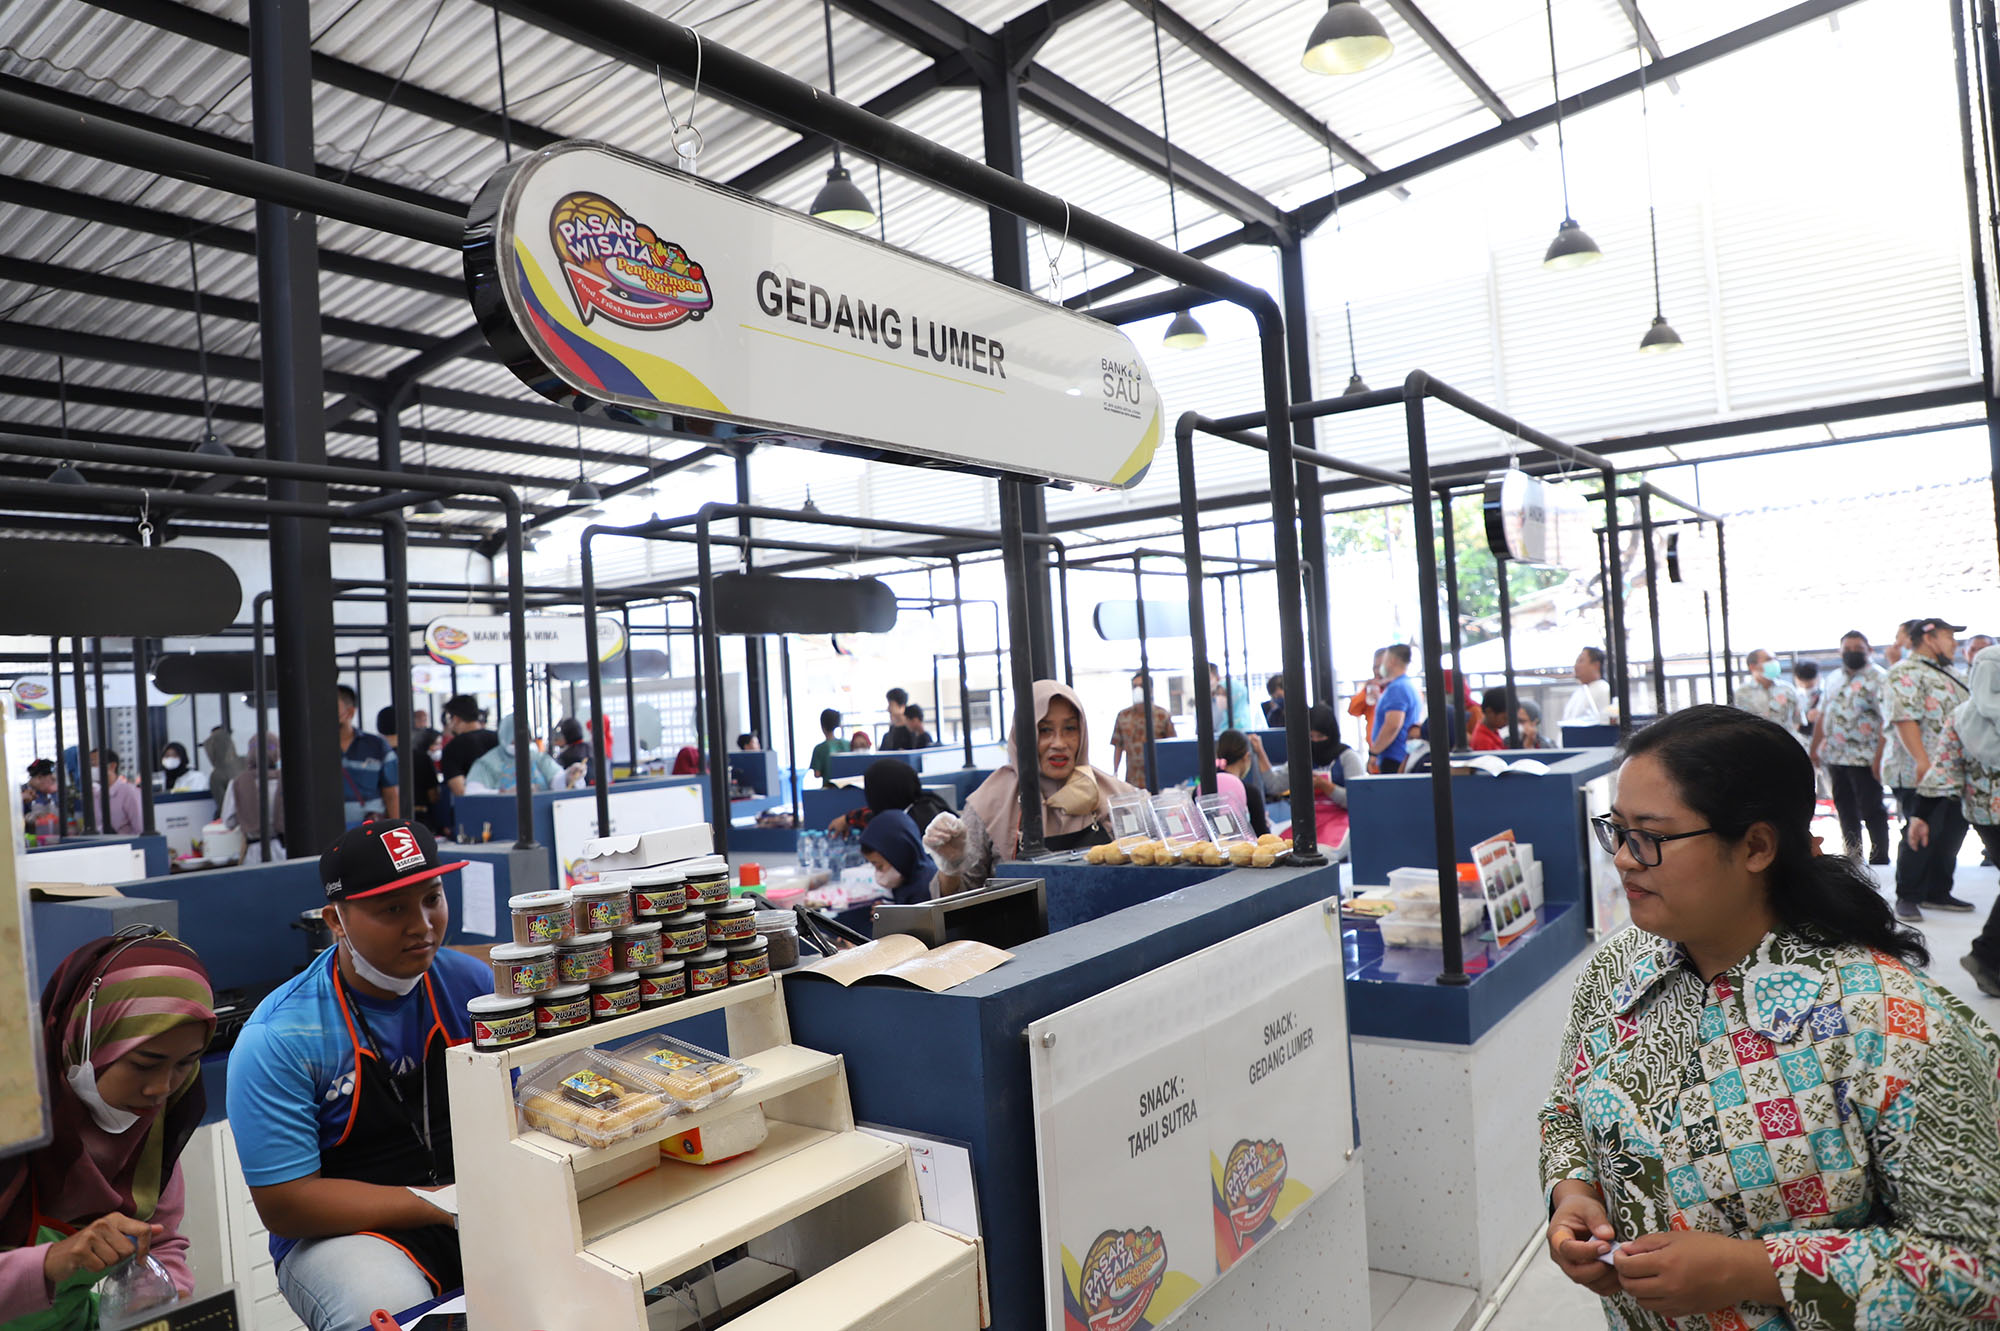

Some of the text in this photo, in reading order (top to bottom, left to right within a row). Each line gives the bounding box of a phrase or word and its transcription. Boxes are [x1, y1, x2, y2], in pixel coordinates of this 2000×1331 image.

[559, 215, 636, 244] PASAR
[568, 236, 653, 266] WISATA
[616, 257, 702, 293] Penjaringan
[646, 278, 678, 298] Sari
[624, 308, 654, 320] Market
[658, 308, 679, 320] Sport
[757, 270, 1006, 380] GEDANG LUMER
[1101, 358, 1128, 378] BANK
[1103, 372, 1140, 405] SAU
[493, 1024, 517, 1036] RUJAK
[1263, 1011, 1293, 1046] SNACK
[1249, 1027, 1315, 1085] GEDANG LUMER
[1139, 1075, 1178, 1118] SNACK
[1128, 1099, 1198, 1159] TAHU SUTRA
[1227, 1145, 1256, 1194] PASAR
[1084, 1236, 1126, 1298] PASAR
[1090, 1248, 1135, 1308] WISATA
